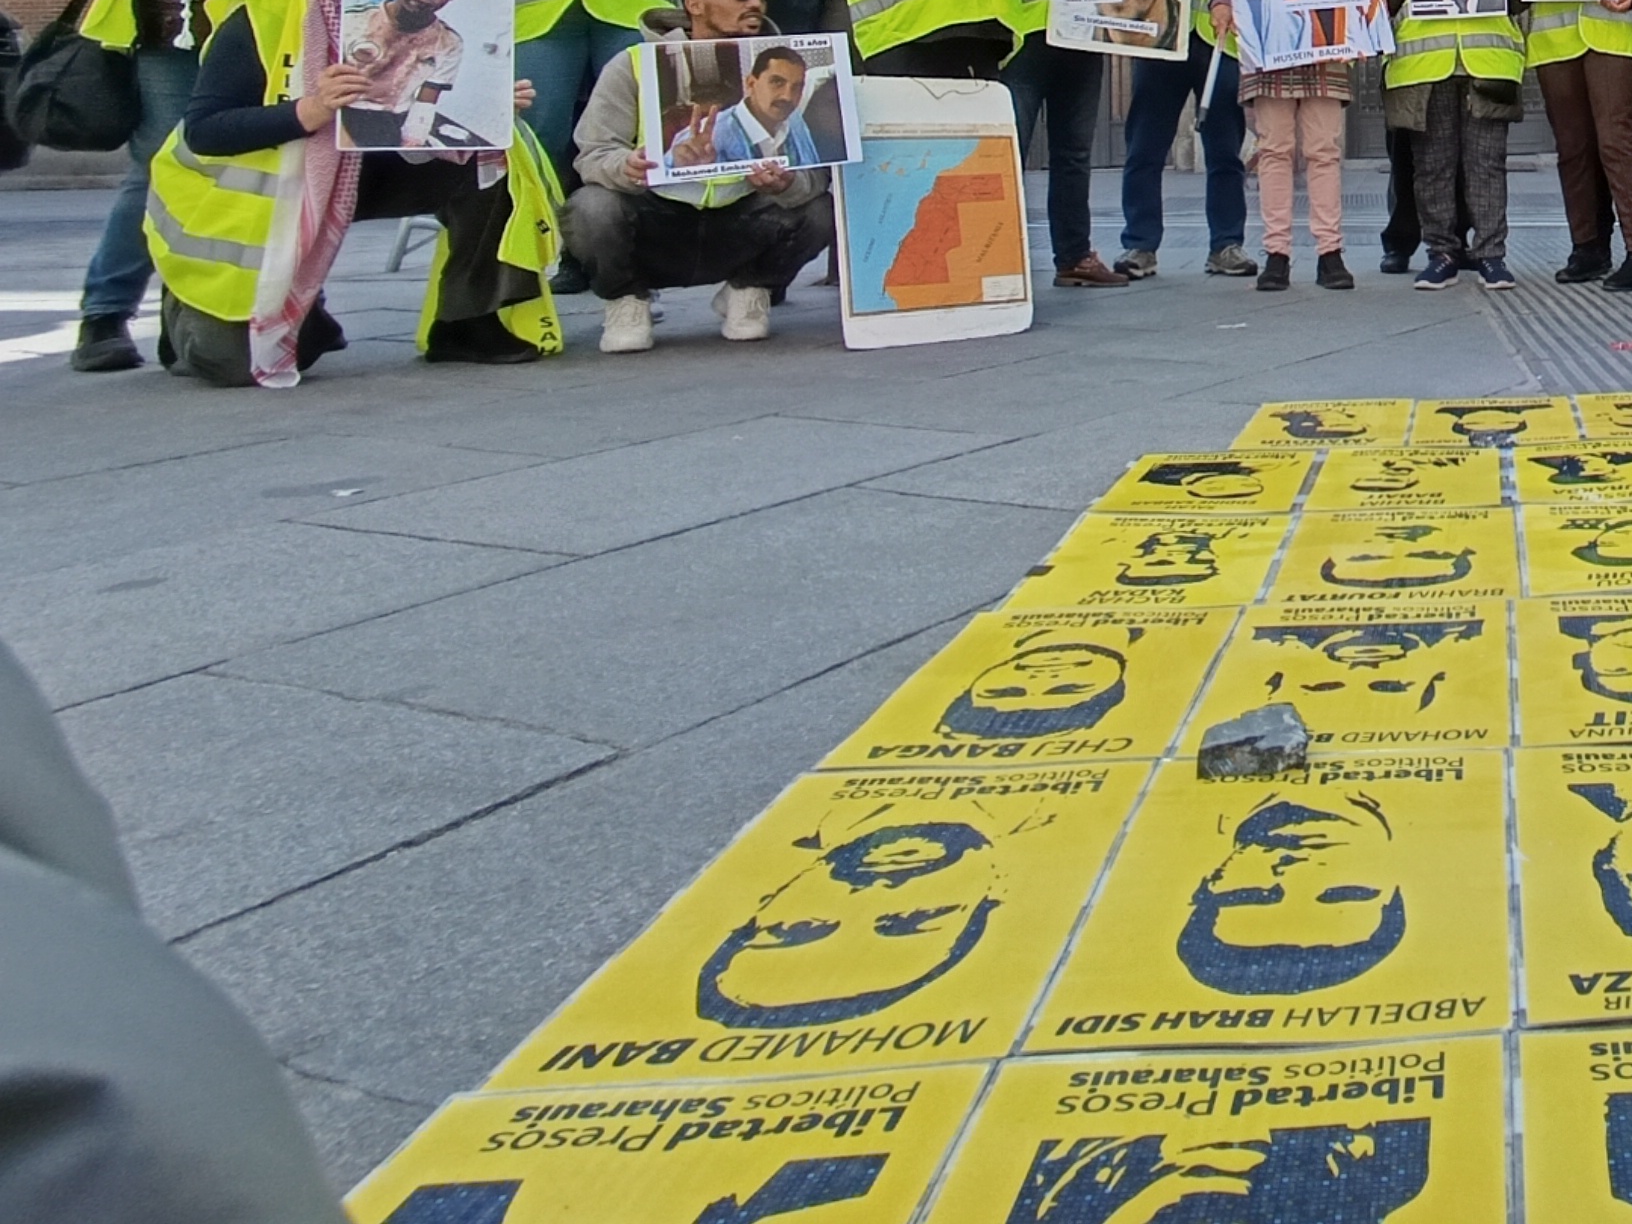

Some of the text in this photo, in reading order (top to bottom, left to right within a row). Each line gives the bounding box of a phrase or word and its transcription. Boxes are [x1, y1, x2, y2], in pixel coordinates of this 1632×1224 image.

[1087, 17, 1126, 28] tratamiento
[1129, 21, 1153, 32] médico
[1273, 50, 1314, 64] HUSSEIN
[672, 165, 718, 178] Mohamed
[1281, 588, 1504, 602] BRAHIM FOURTAT
[1002, 616, 1206, 630] Libertad Presos
[1009, 610, 1209, 623] Políticos Saharauis
[1341, 728, 1488, 744] MOHAMED
[866, 737, 1133, 759] CHEJ BANGA
[1353, 756, 1463, 769] Políticos
[843, 768, 1109, 789] Políticos Saharauis
[1198, 766, 1463, 785] Libertad Presos
[828, 779, 1103, 801] Libertad Presos
[1055, 996, 1486, 1036] ABDELLAH BRAH SIDI
[537, 1016, 988, 1072] MOHAMED BANI
[1068, 1050, 1446, 1092] Políticos Saharauis
[510, 1080, 920, 1129] Políticos Saharauis
[1056, 1073, 1444, 1118] Libertad Presos
[479, 1105, 908, 1155] Libertad Presos
